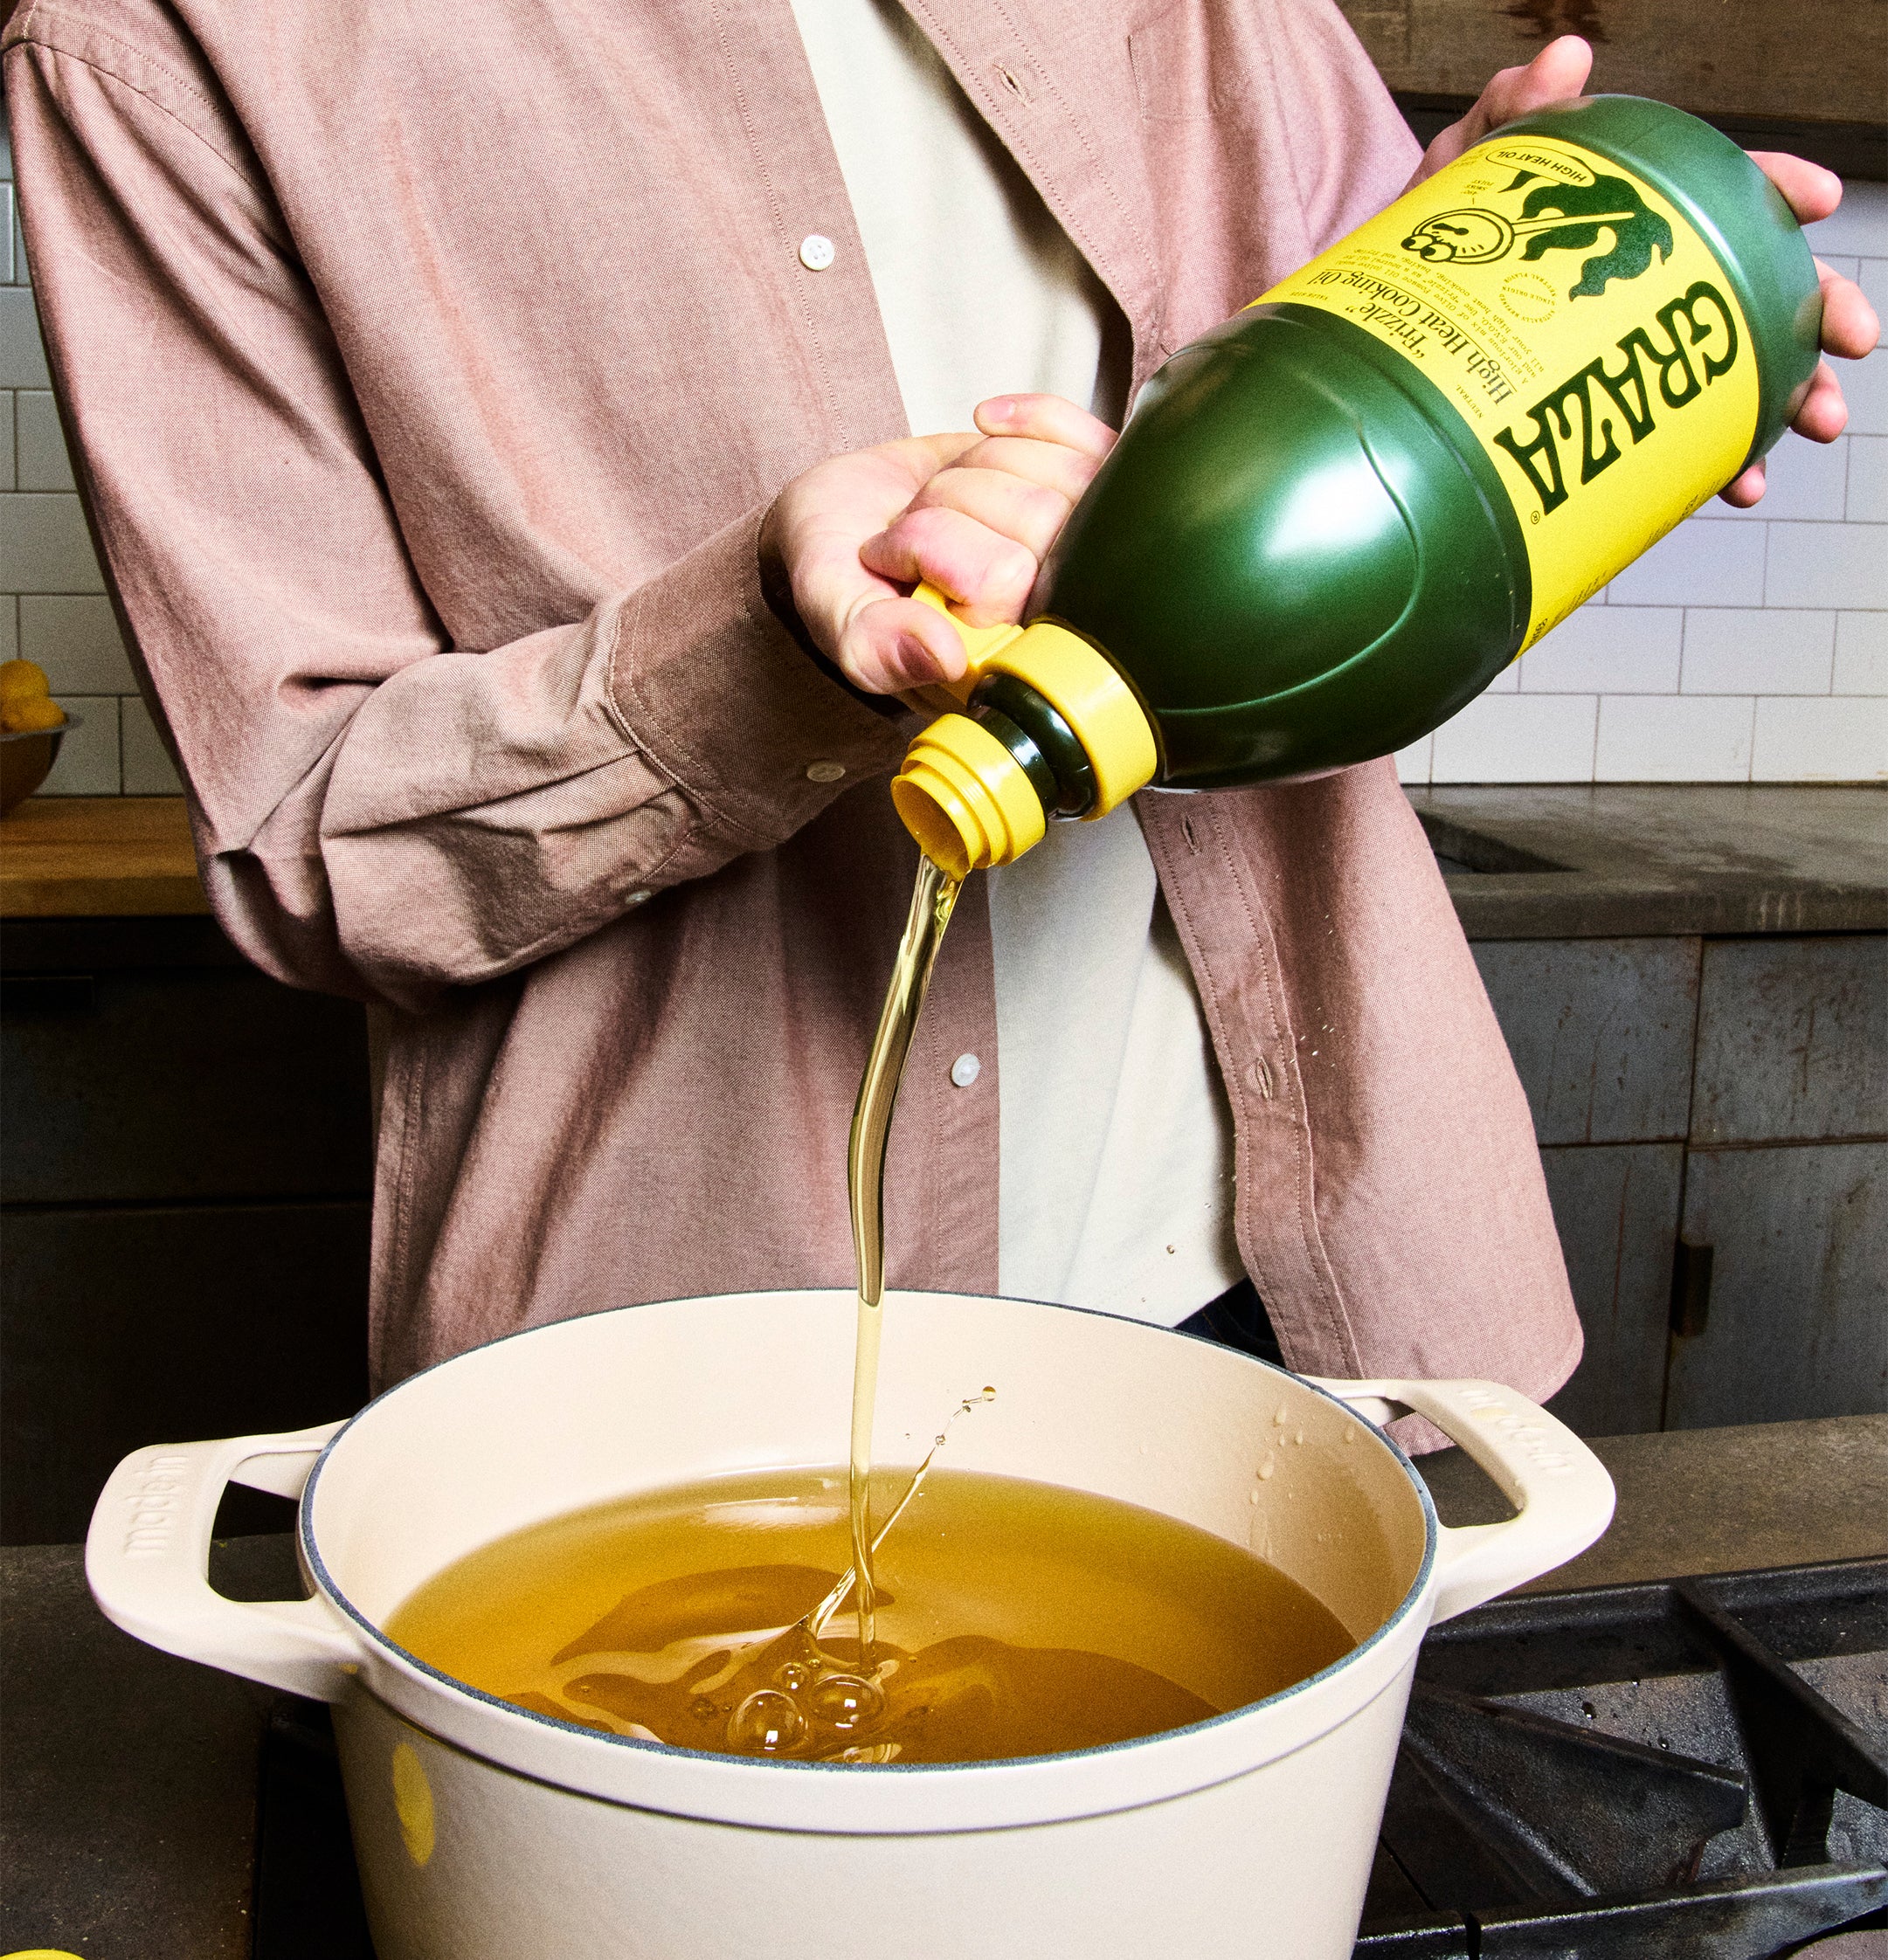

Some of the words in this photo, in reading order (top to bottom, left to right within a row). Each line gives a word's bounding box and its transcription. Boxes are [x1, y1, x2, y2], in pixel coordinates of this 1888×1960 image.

[1516, 154, 1552, 166] HEAT
[1551, 162, 1587, 182] HIGH
[1383, 268, 1400, 279] Oil
[1400, 256, 1432, 274] baking,
[1307, 272, 1342, 285] Oil
[1411, 270, 1422, 279] as
[1401, 276, 1432, 295] Pomace
[1435, 272, 1471, 297] cooking,
[1501, 286, 1529, 297] ORIGIN
[1532, 273, 1556, 298] NEUTRAL
[1341, 272, 1421, 316] Cooking
[1433, 293, 1457, 312] Olive
[1530, 293, 1555, 307] SINGLE
[1463, 303, 1478, 317] Use
[1472, 297, 1492, 315] heat
[1456, 311, 1470, 321] of
[1492, 314, 1512, 335] high
[1419, 312, 1470, 355] Heat
[1470, 321, 1488, 337] mix
[1481, 316, 1509, 345] E.V.O.O.
[1507, 346, 1523, 361] our
[1511, 335, 1532, 355] your
[1488, 337, 1523, 376] glorious
[1530, 357, 1545, 373] all
[1467, 350, 1512, 404] High
[1521, 361, 1537, 378] and
[1521, 376, 1529, 385] A
[1456, 385, 1483, 419] NEUTRAL
[1494, 280, 1739, 516] GRAZA
